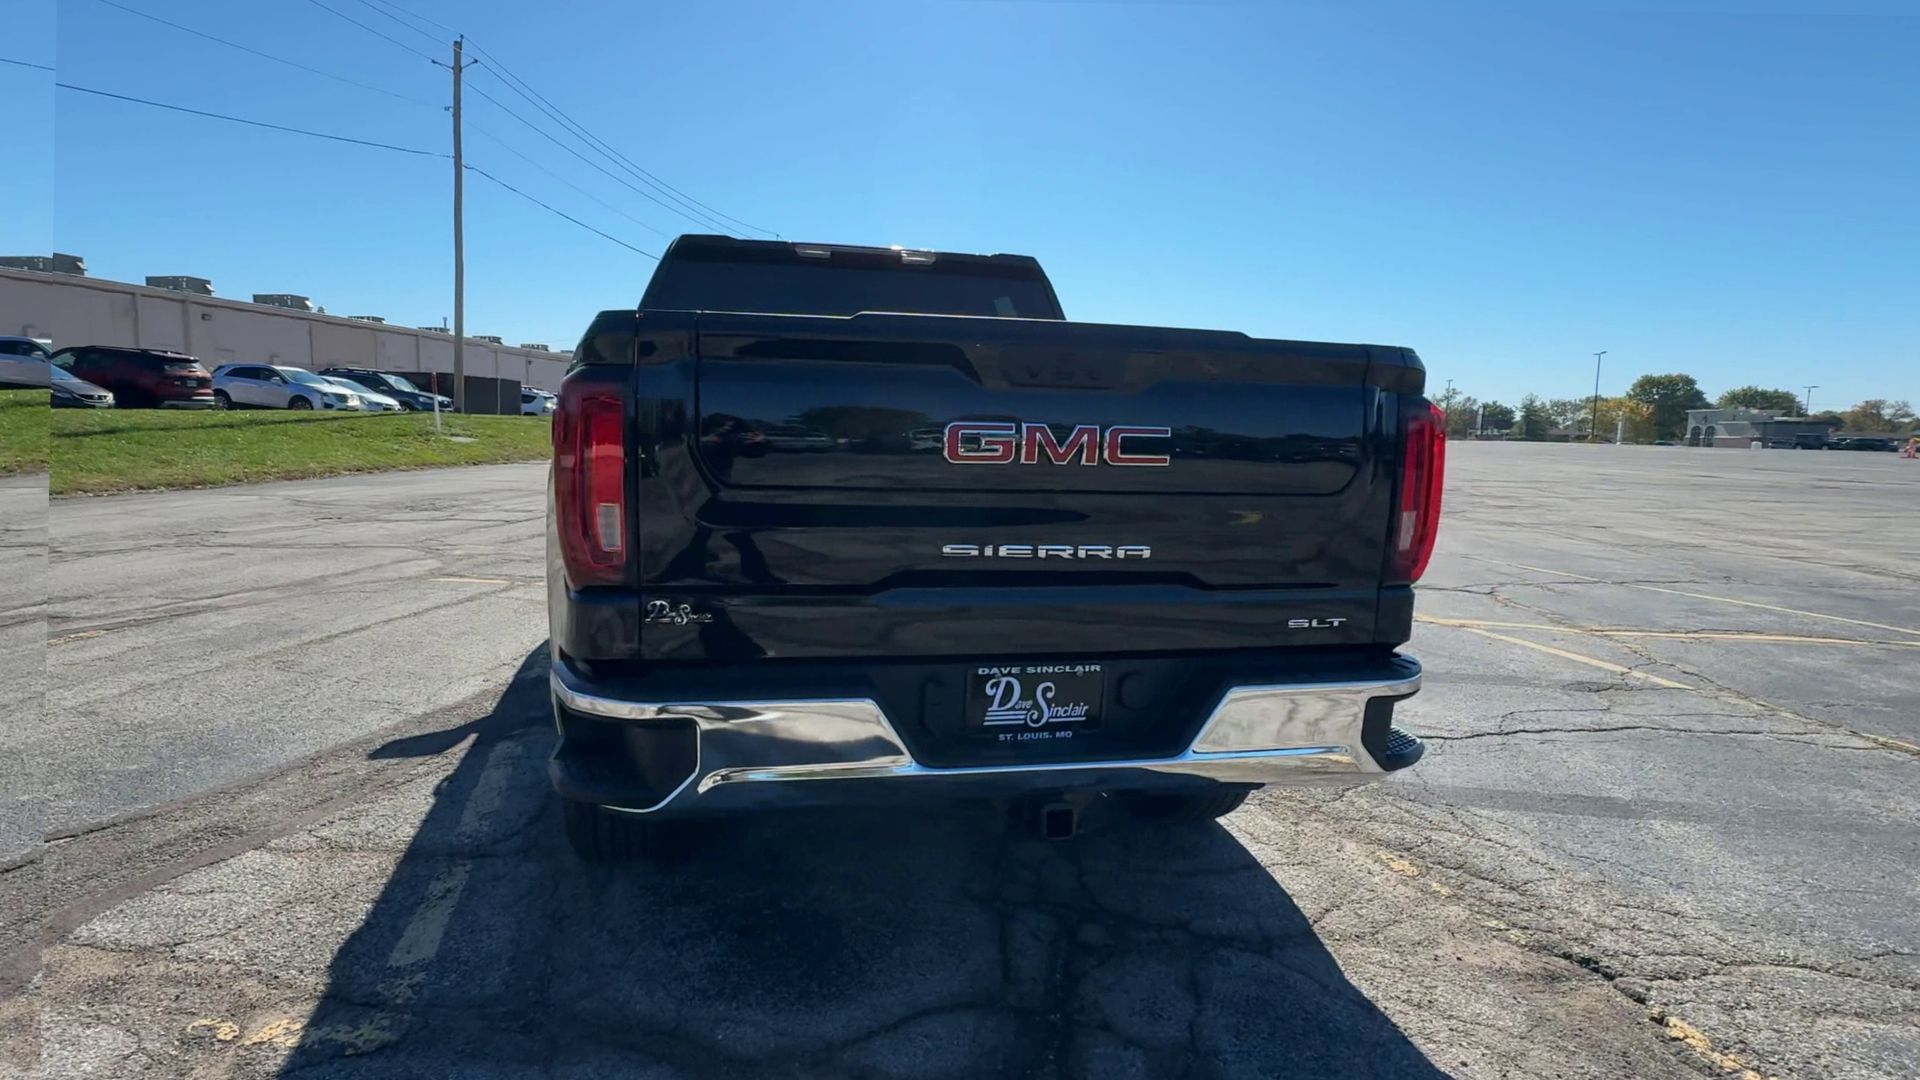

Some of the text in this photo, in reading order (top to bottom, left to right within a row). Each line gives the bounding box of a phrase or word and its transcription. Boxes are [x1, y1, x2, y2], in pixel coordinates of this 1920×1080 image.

[943, 422, 1172, 466] GMC
[942, 544, 1152, 559] SIERRA
[1287, 618, 1348, 628] SLT
[978, 664, 1102, 675] DAVE SINCLAIR
[985, 676, 1089, 728] Dave Sinclair
[998, 733, 1014, 741] ST.
[1055, 730, 1073, 739] MO
